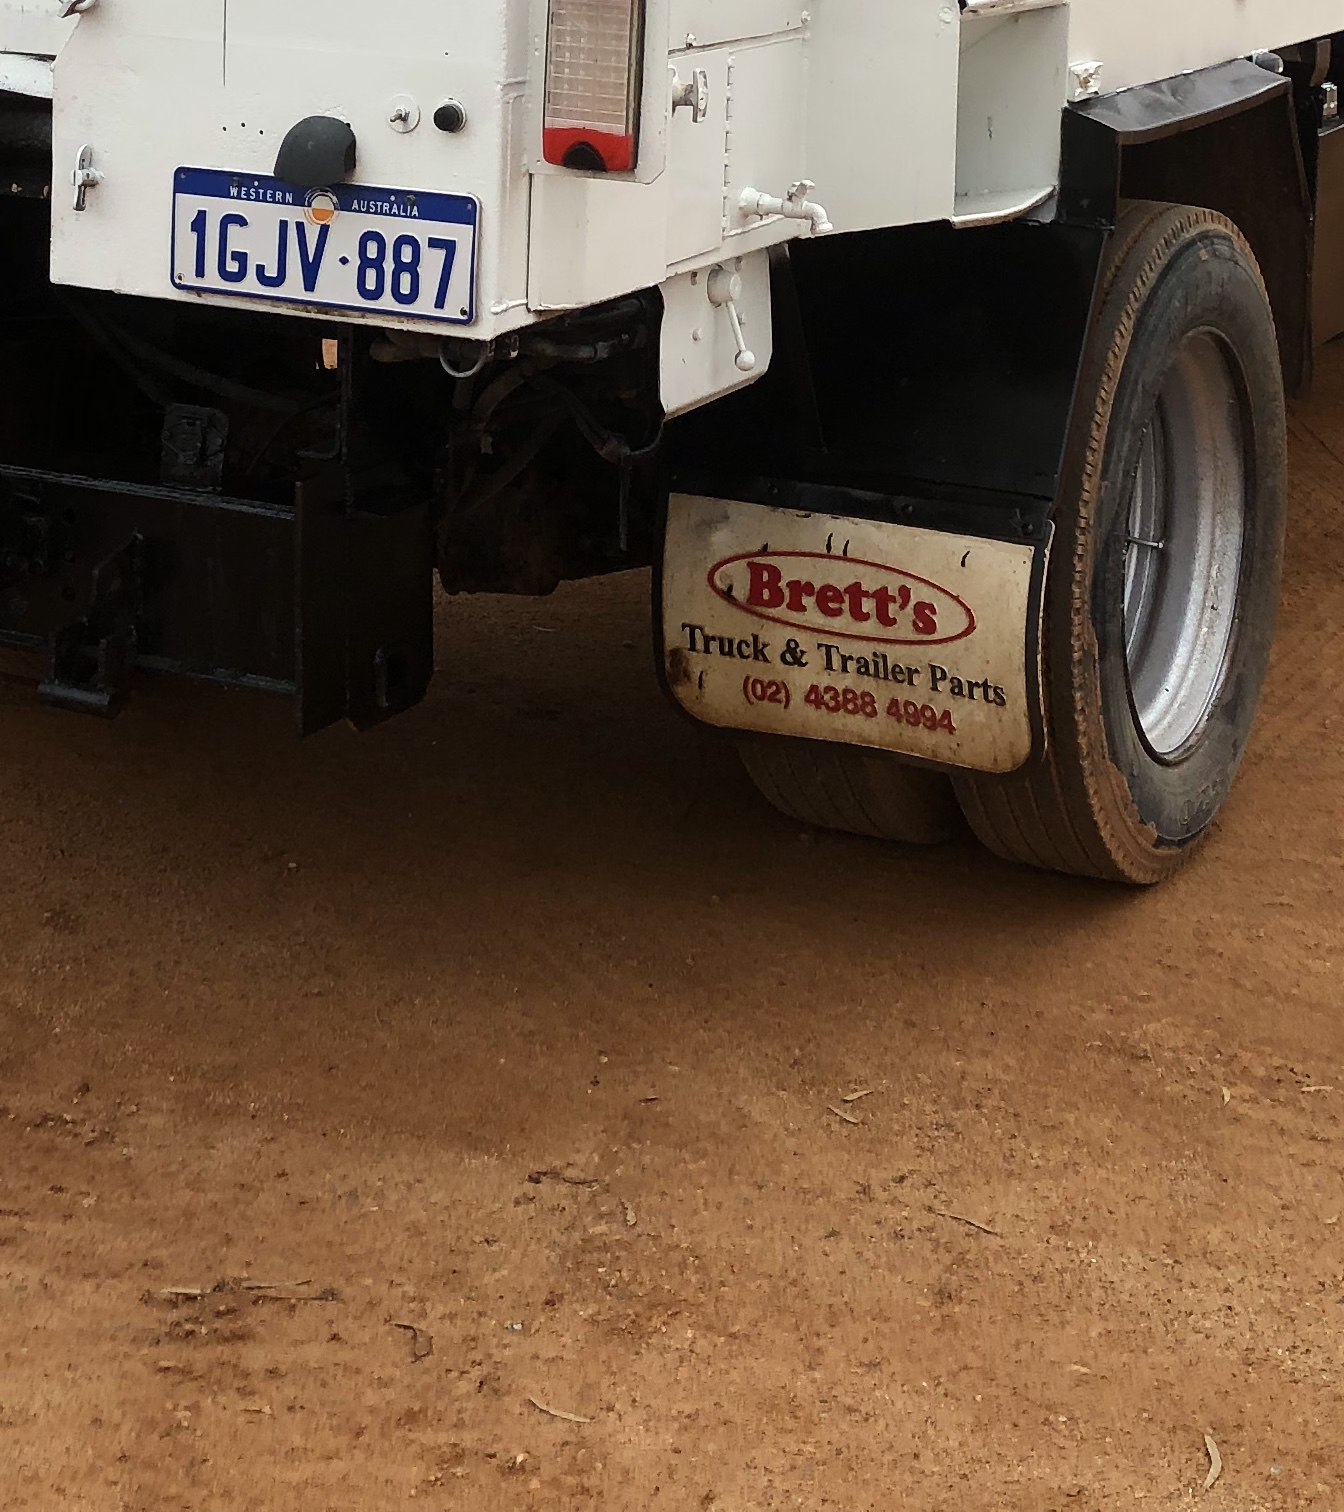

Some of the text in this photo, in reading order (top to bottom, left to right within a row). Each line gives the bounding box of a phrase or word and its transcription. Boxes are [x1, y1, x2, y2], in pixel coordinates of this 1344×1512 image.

[229, 186, 419, 218] WESTERN AUSTRALIA
[747, 561, 938, 635] Brett's
[681, 623, 1007, 707] Truck & Trailer Parts
[742, 675, 957, 735] (02) 4388 4994
